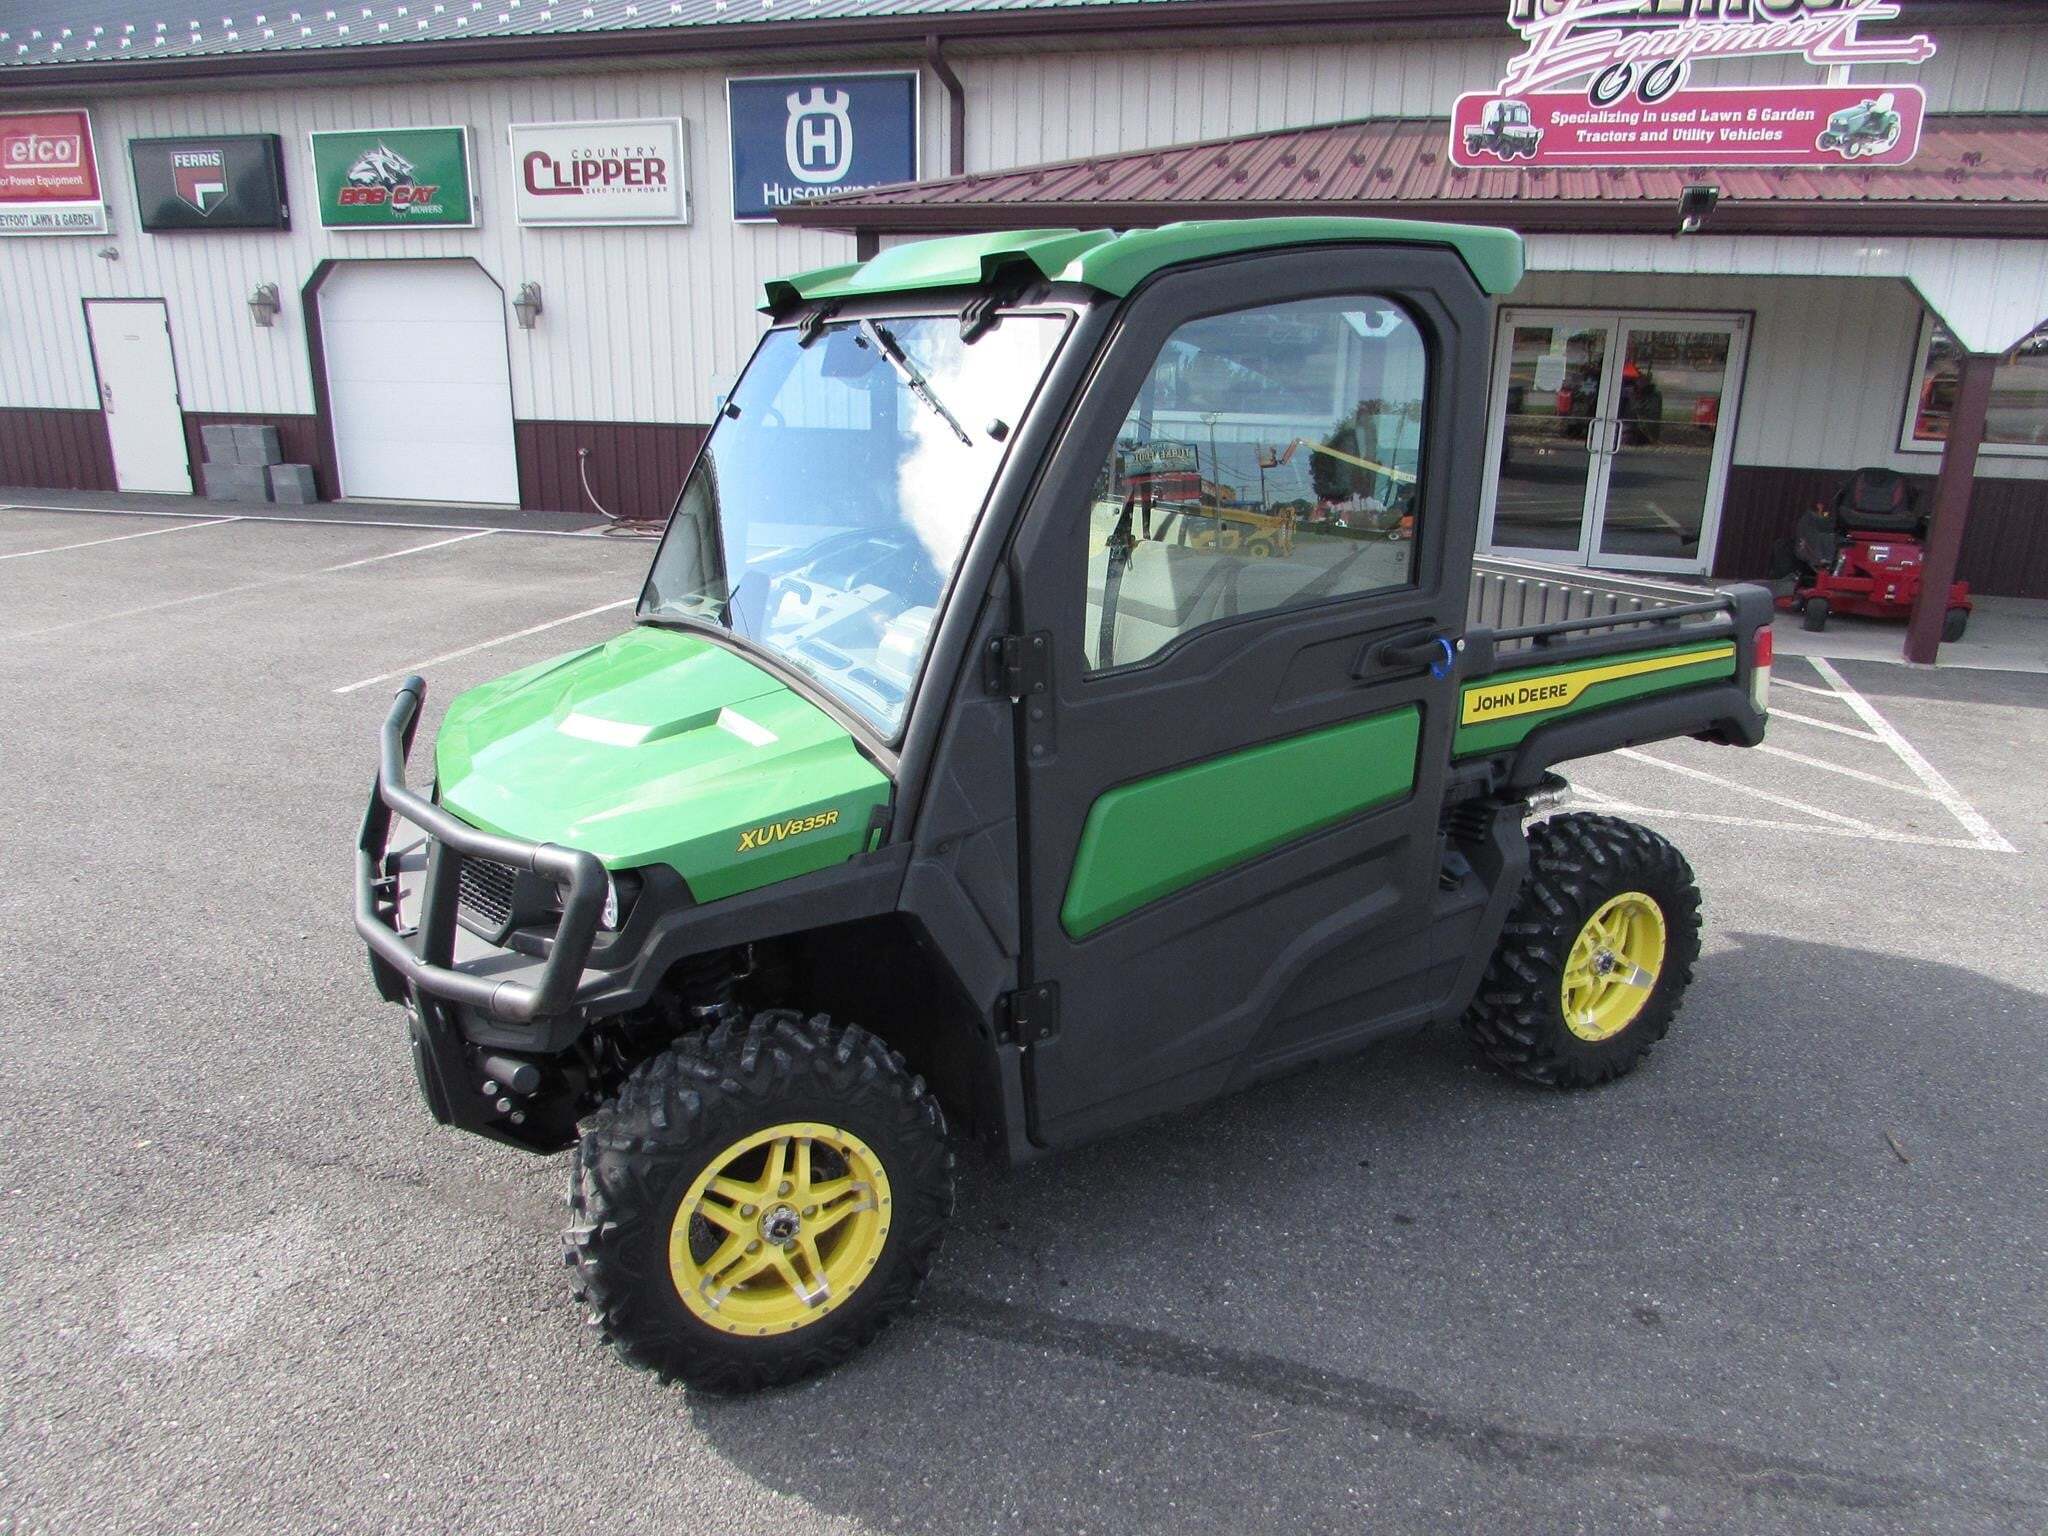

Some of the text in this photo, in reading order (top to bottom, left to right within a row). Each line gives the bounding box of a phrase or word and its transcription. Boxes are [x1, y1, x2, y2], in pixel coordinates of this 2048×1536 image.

[1502, 0, 1930, 96] Equipment
[1551, 108, 1815, 126] Specializing in used Lawn & Garden
[1576, 128, 1783, 144] Tractors and Utility Vehicles
[12, 134, 72, 162] efco
[571, 146, 658, 160] COUNTRY
[174, 152, 221, 168] FERRIS
[10, 175, 35, 186] Power
[36, 175, 84, 188] Equipment
[523, 150, 667, 196] CLIPPER
[410, 204, 443, 214] MOWERS
[30, 213, 52, 226] LAWN
[62, 212, 95, 225] GARDEN
[1472, 683, 1568, 713] JOHN DEERE
[737, 809, 840, 853] XUV835R
